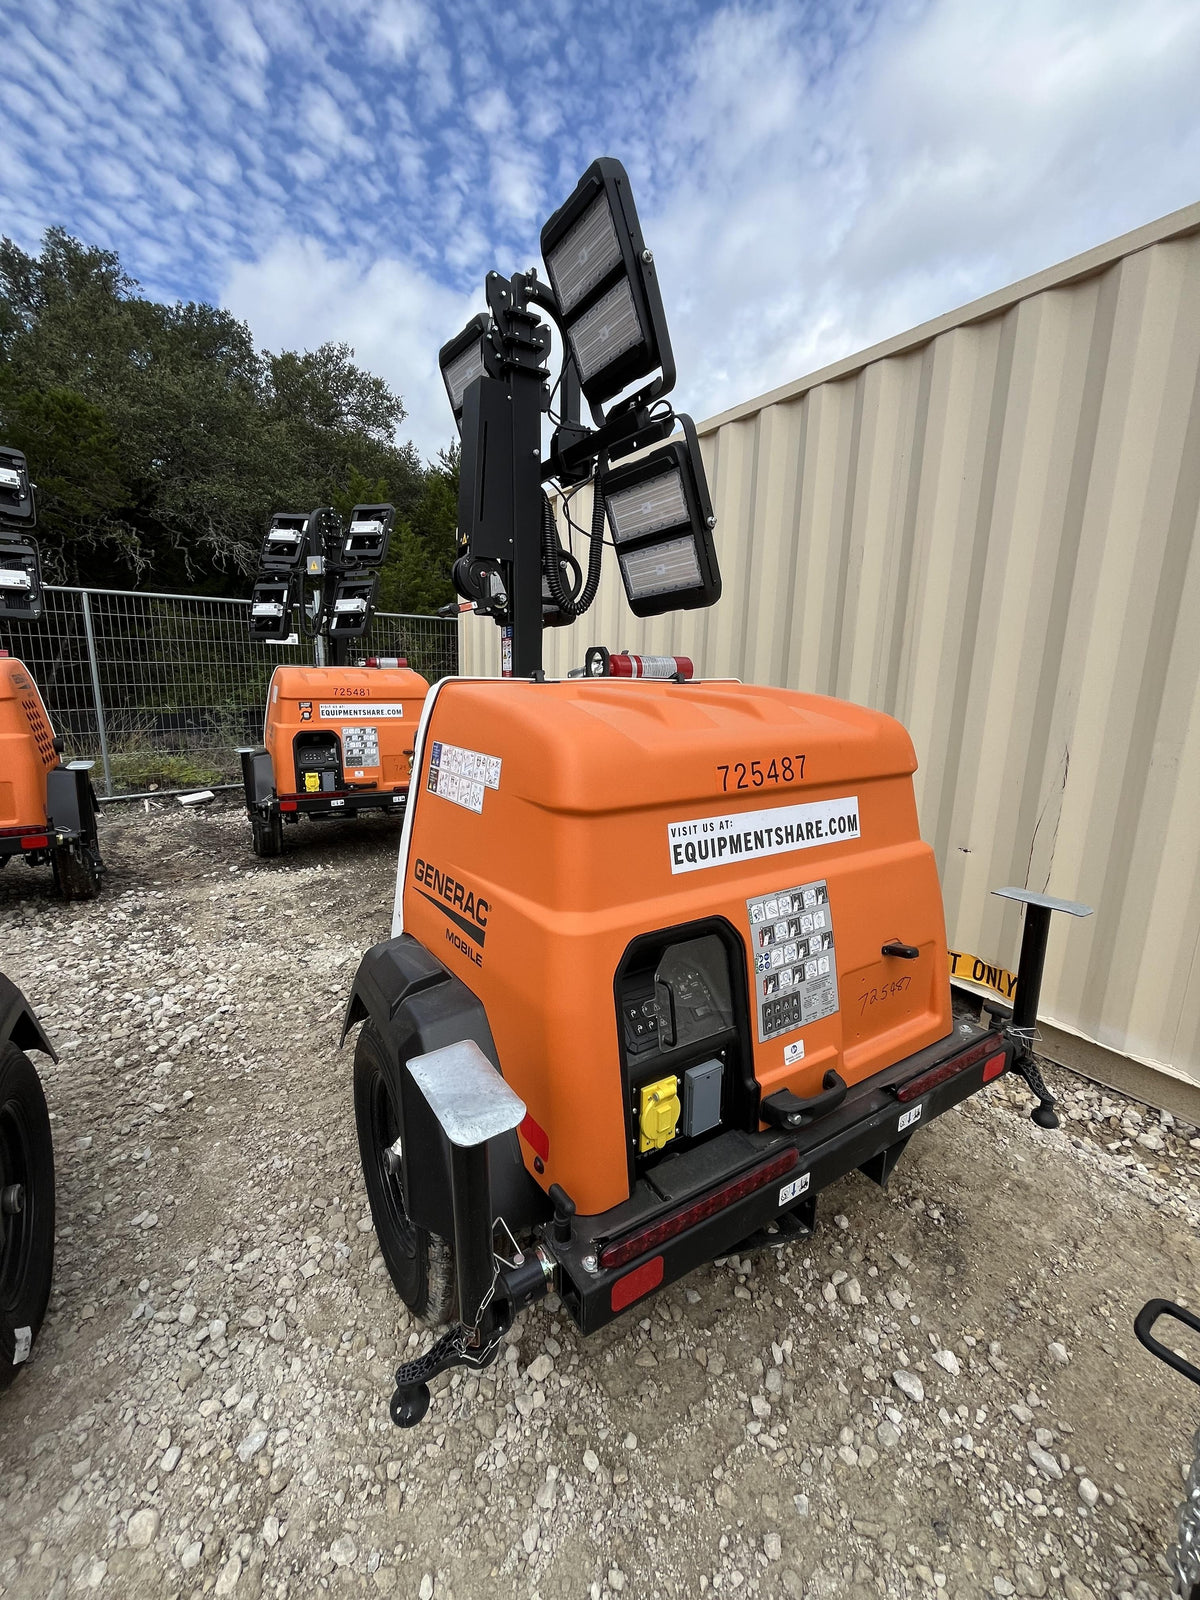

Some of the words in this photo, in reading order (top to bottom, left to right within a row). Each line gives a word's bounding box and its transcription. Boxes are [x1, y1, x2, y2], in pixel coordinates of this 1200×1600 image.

[333, 687, 371, 696] 725481
[717, 755, 806, 791] 725487
[671, 824, 698, 837] VISIT
[702, 822, 715, 832] US
[719, 819, 733, 830] AT:
[673, 813, 858, 865] EQUIPMENTSHARE.COM
[414, 858, 489, 927] GENERAC
[445, 928, 483, 968] MOBILE
[858, 976, 912, 1016] 725487
[972, 959, 1018, 998] ONLY
